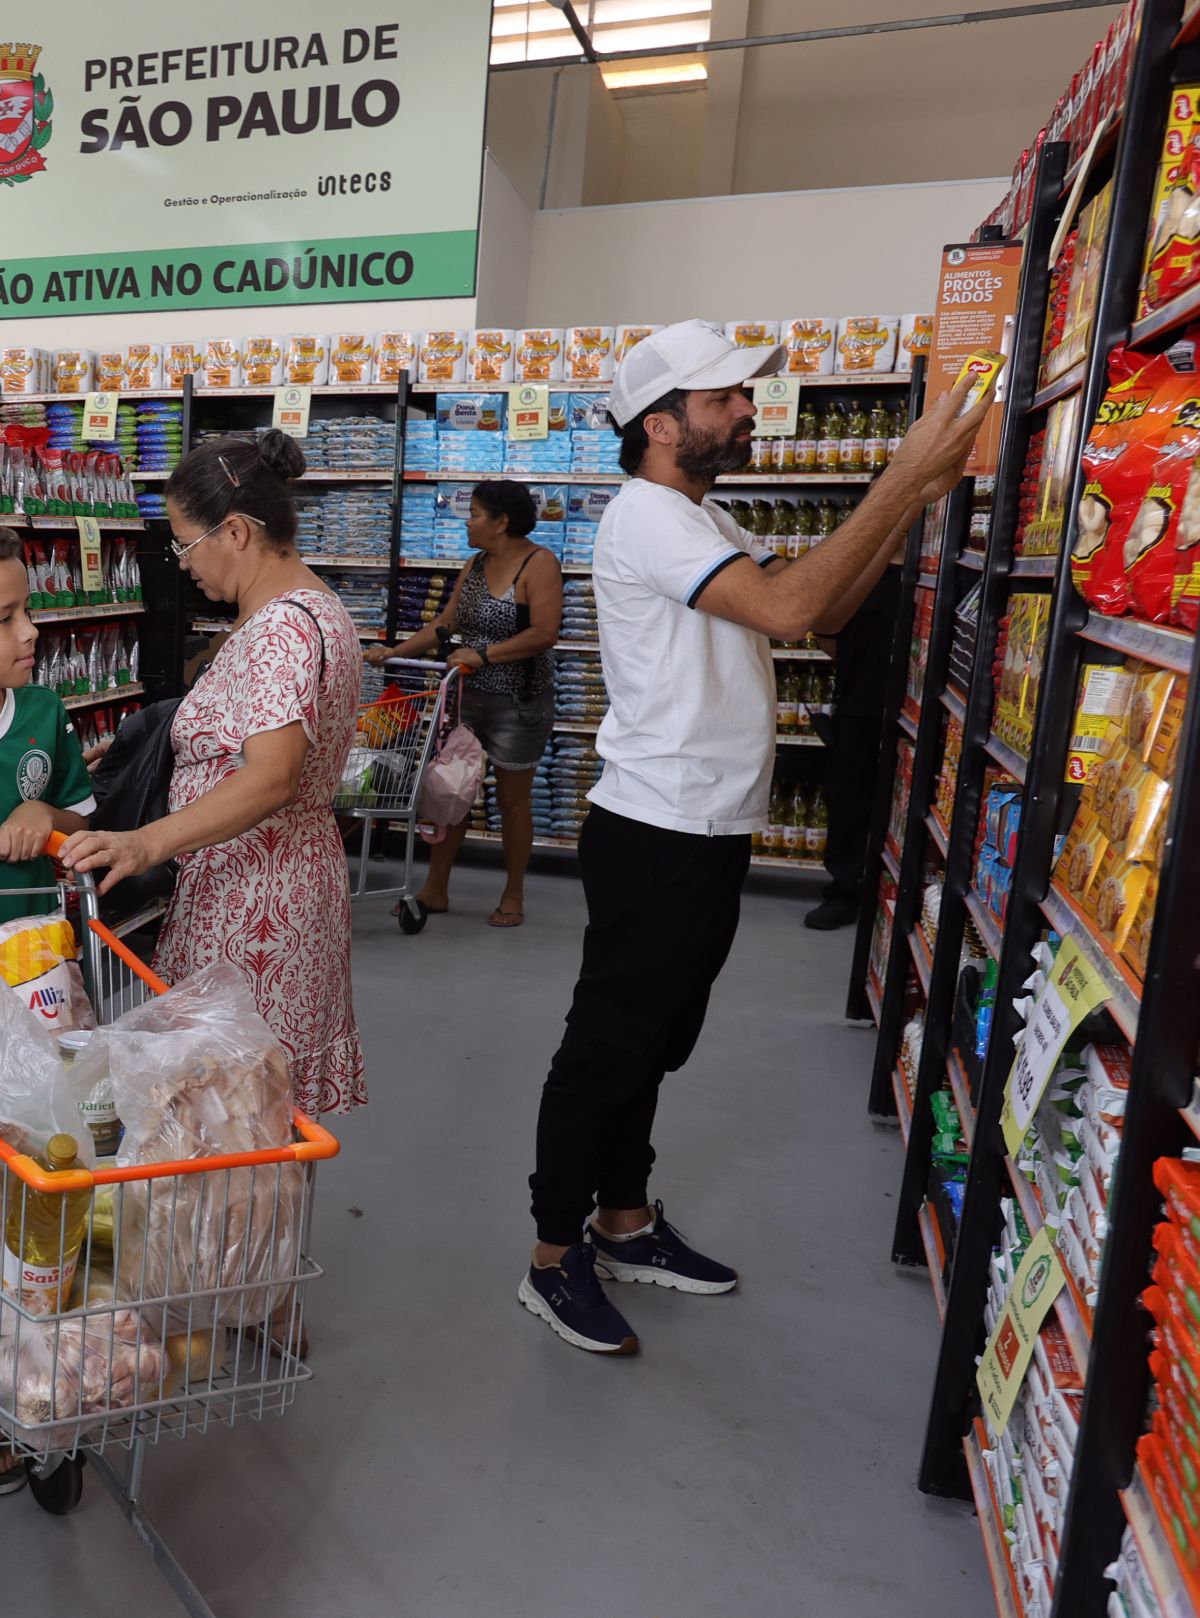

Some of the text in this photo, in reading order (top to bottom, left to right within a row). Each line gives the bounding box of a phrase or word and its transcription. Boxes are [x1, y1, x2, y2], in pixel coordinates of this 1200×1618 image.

[85, 23, 399, 92] PREFEITURA DE
[79, 78, 401, 154] SÃO PAULO
[164, 195, 200, 209] Gestão
[210, 188, 307, 206] Operacionalização
[43, 266, 141, 303] ATIVA
[150, 262, 202, 297] NO
[212, 249, 414, 294] CADÚNICO
[943, 269, 992, 280] ALIMENTOS
[943, 277, 1003, 292] PROCES
[941, 290, 993, 304] SADOS
[969, 363, 991, 373] Apti
[454, 409, 477, 417] Benta
[456, 403, 475, 411] Dona
[1071, 758, 1085, 780] Apti
[29, 986, 65, 1010] Alliz
[1004, 1331, 1013, 1351] 2
